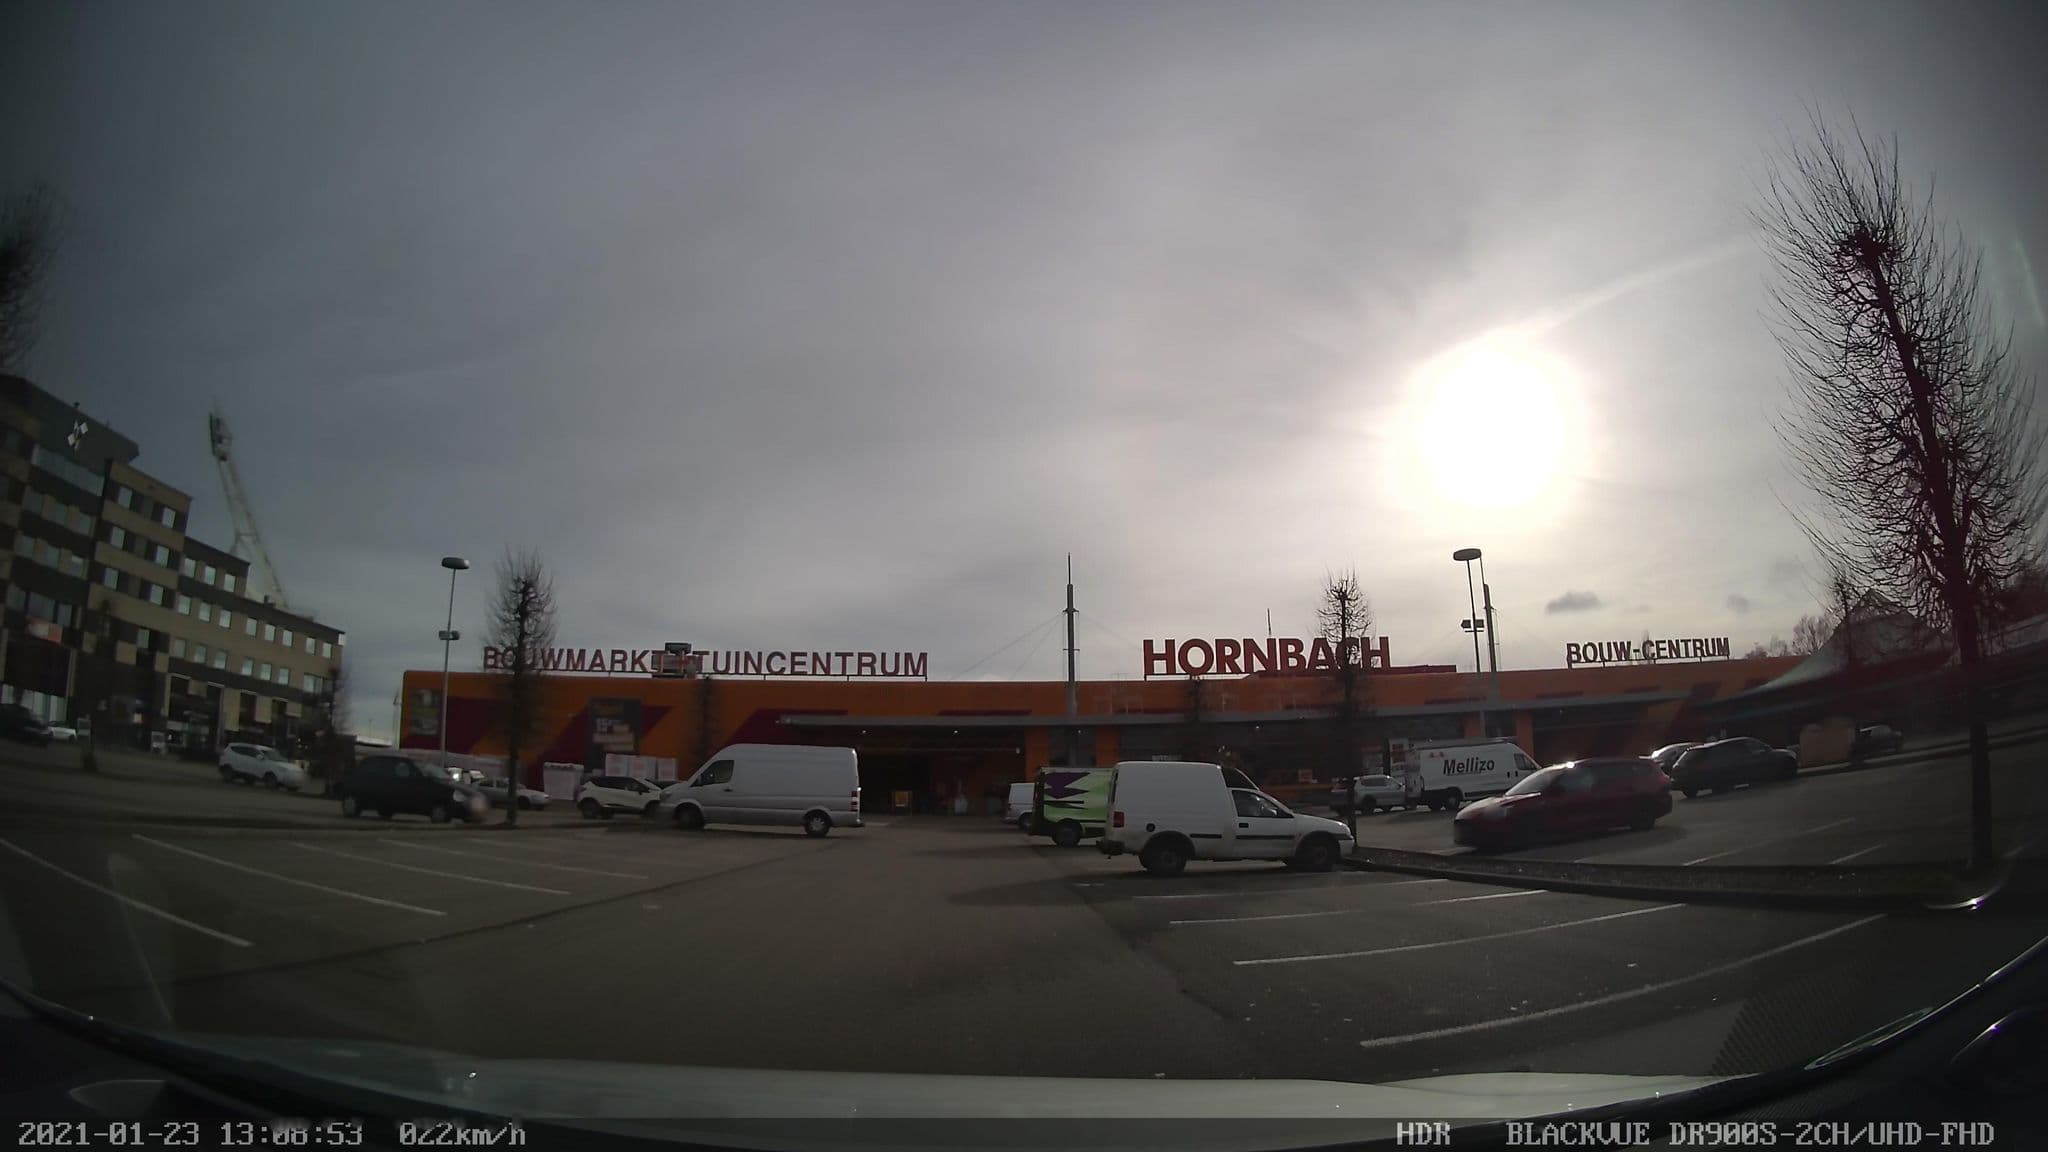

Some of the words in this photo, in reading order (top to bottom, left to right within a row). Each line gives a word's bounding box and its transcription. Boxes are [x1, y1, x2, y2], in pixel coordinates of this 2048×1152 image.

[692, 650, 928, 676] TUINCENTRUM
[1143, 636, 1391, 675] HORNBACH
[1566, 637, 1730, 663] BOUW-CENTRUM
[1443, 757, 1495, 776] Mellizo
